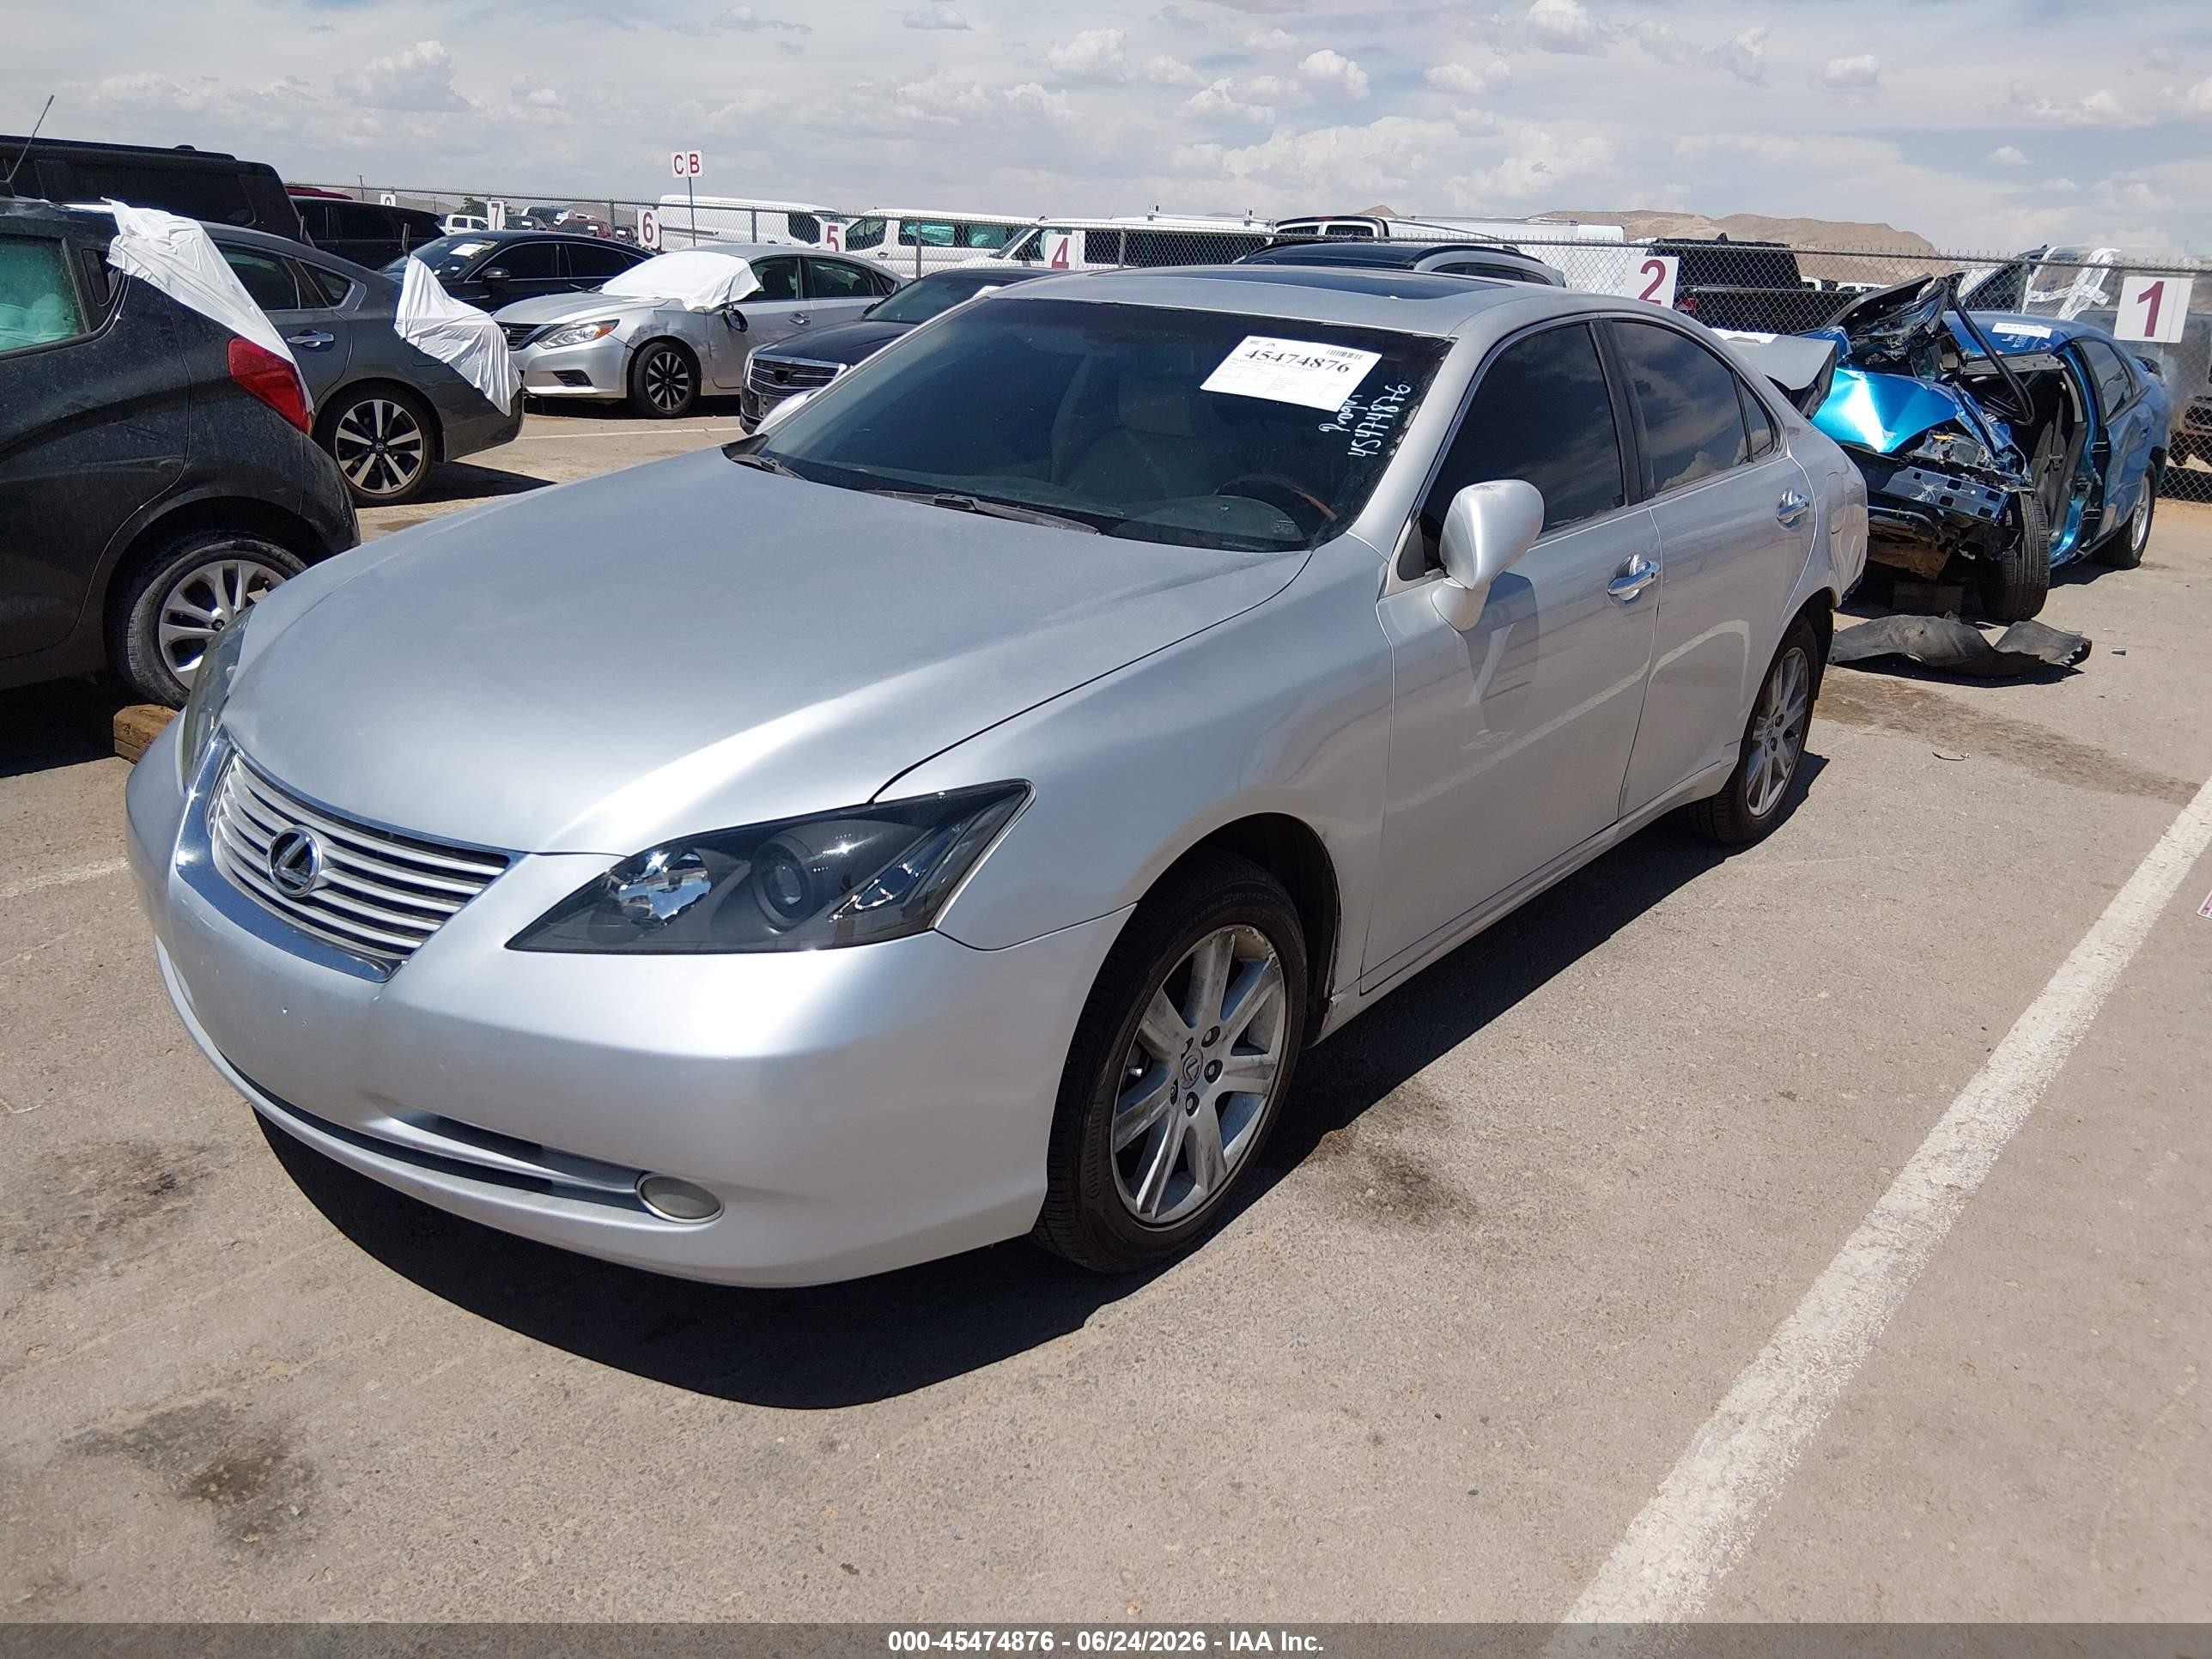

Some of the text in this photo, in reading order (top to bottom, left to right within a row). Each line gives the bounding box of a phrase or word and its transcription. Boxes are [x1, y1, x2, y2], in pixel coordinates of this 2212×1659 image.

[490, 203, 501, 230] 7
[642, 212, 654, 243] 6
[826, 225, 839, 252] 5
[1051, 237, 1070, 270] 4
[1639, 259, 1667, 305] 2
[2137, 281, 2165, 337] 1
[1244, 349, 1352, 374] 45474876
[1347, 384, 1411, 457] 45474876
